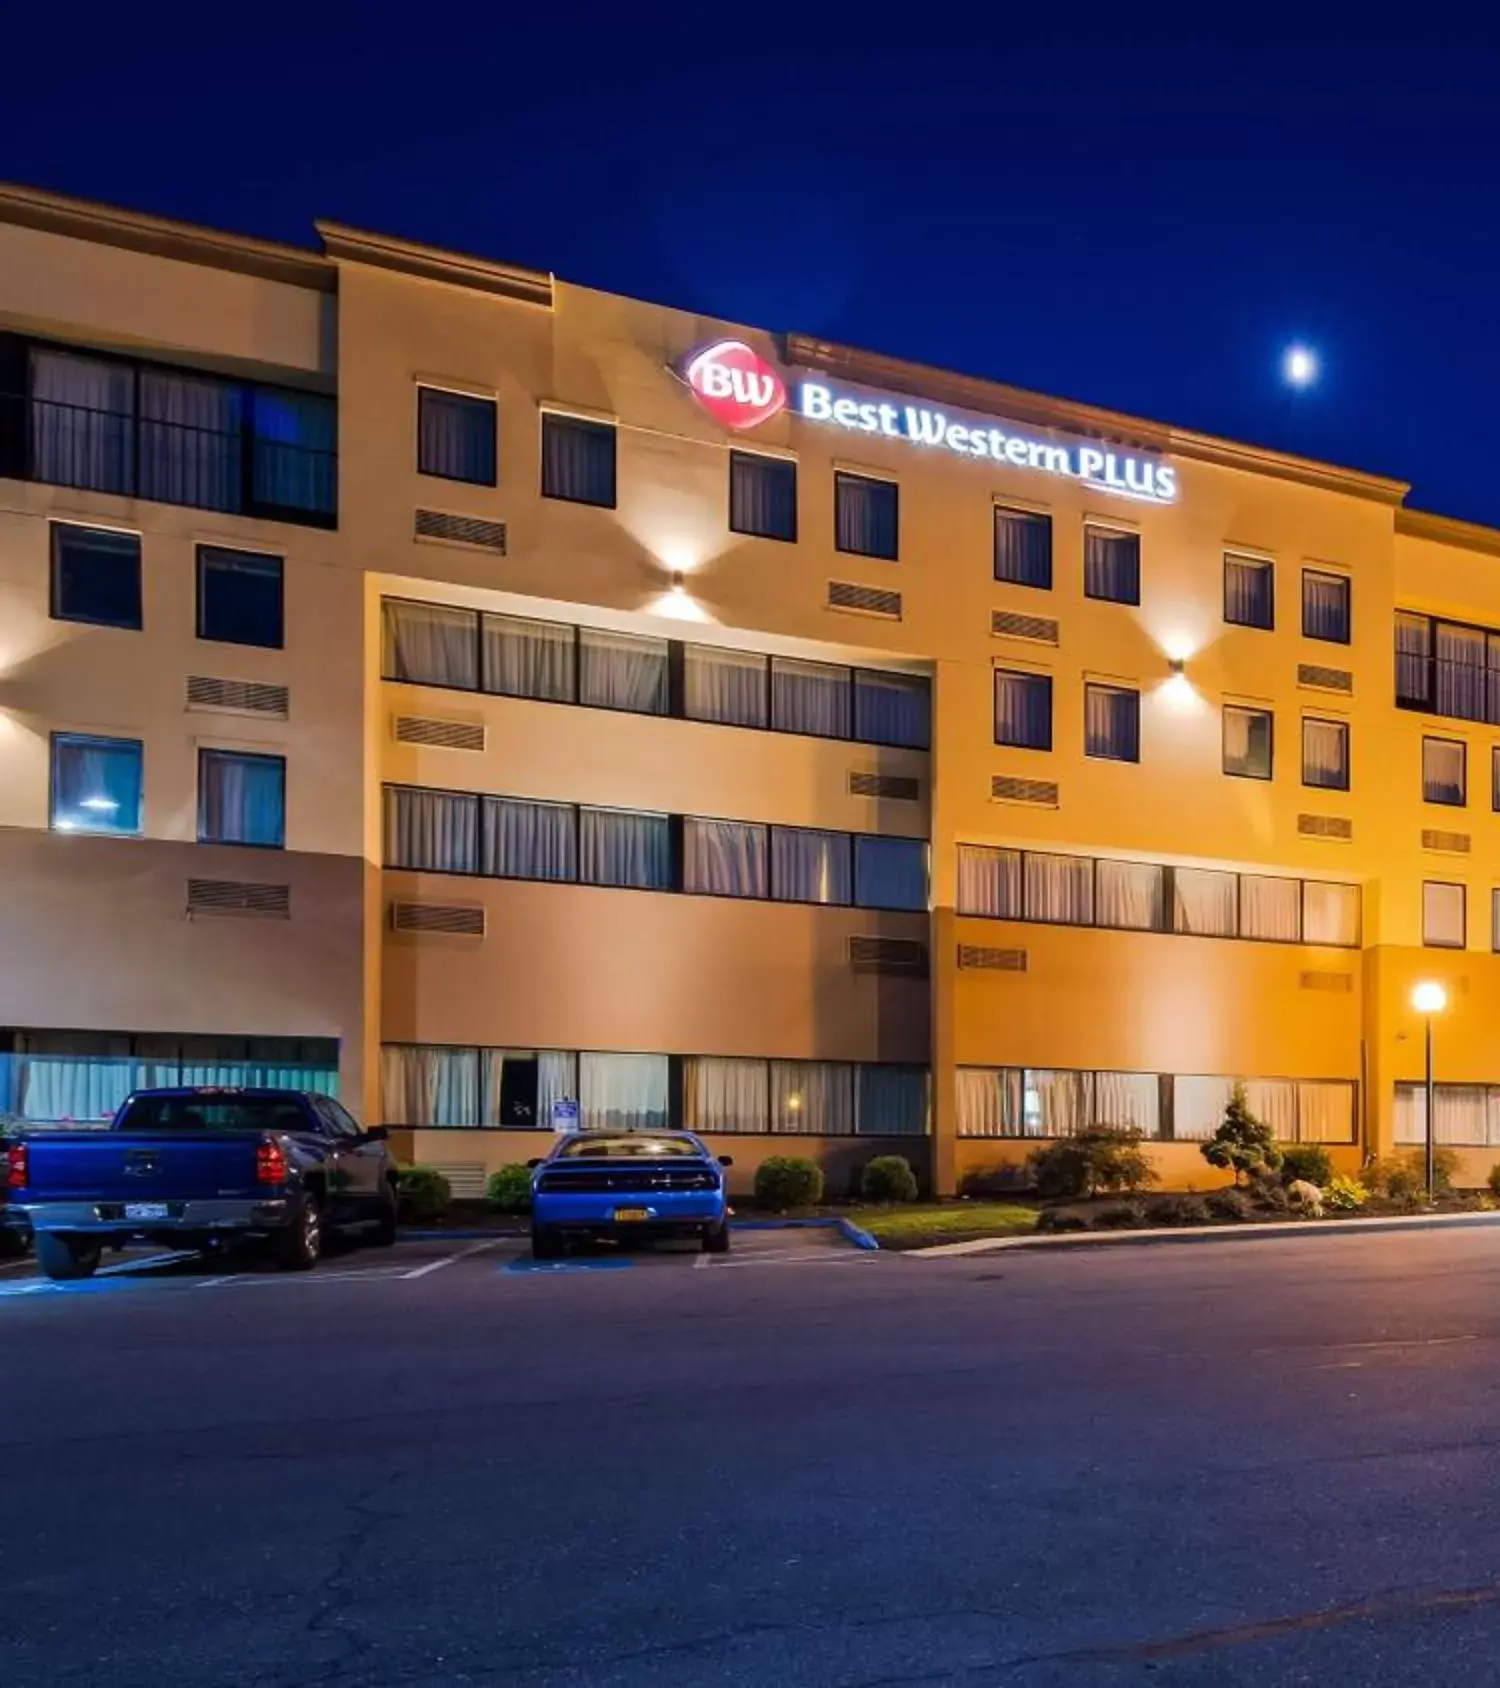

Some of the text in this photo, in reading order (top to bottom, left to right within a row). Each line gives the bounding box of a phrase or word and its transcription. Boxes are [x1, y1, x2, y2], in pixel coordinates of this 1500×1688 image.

[702, 362, 775, 407] BW
[802, 383, 1177, 498] Best Western PLUS
